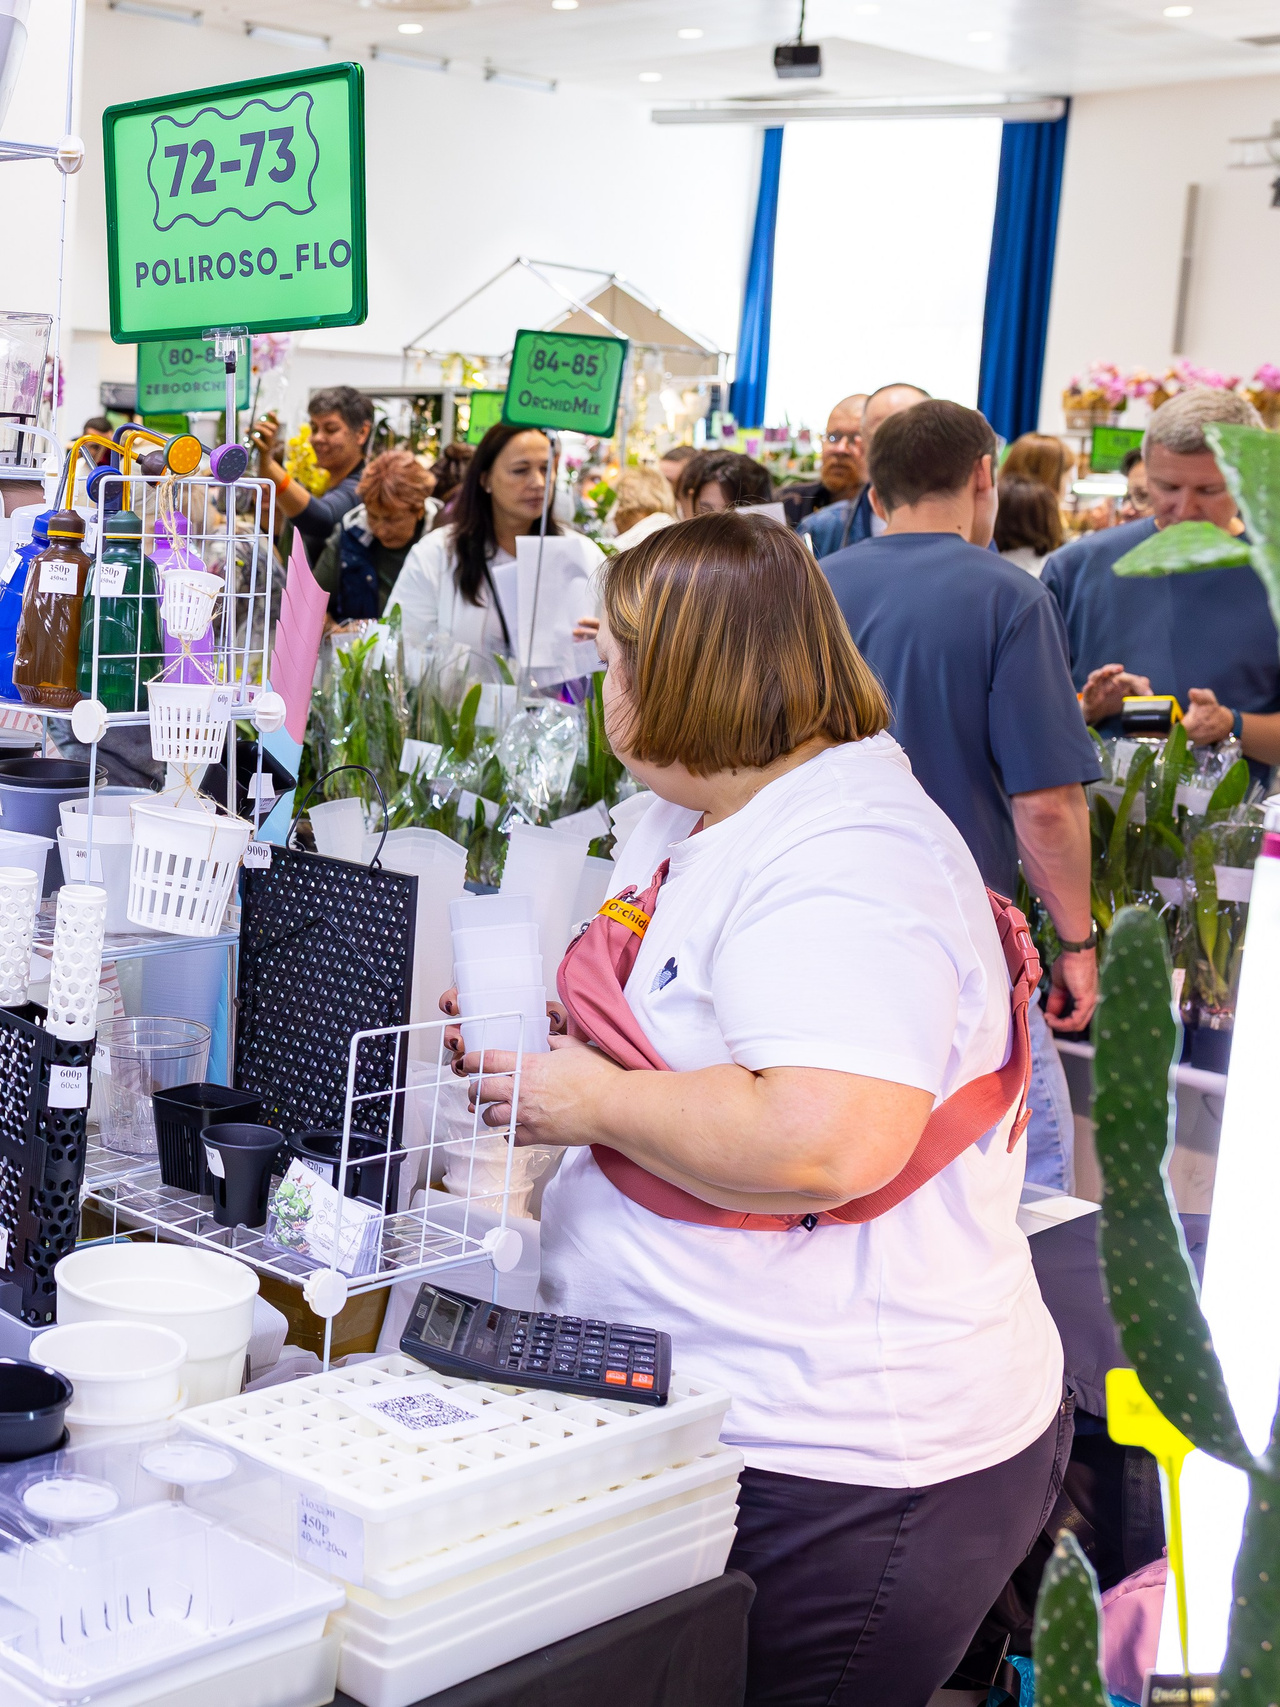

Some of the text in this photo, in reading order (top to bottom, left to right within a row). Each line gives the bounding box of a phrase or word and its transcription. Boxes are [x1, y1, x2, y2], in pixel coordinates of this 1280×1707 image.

[164, 126, 296, 198] 72-73
[135, 239, 352, 288] POLIROSO_FLO
[169, 347, 229, 365] 80-8
[533, 350, 599, 377] 84-85
[48, 564, 70, 576] 350р
[100, 566, 120, 579] 350р
[217, 694, 229, 705] 60р
[246, 845, 269, 859] 900р
[59, 1069, 82, 1080] 600р
[301, 1512, 330, 1537] 450р
